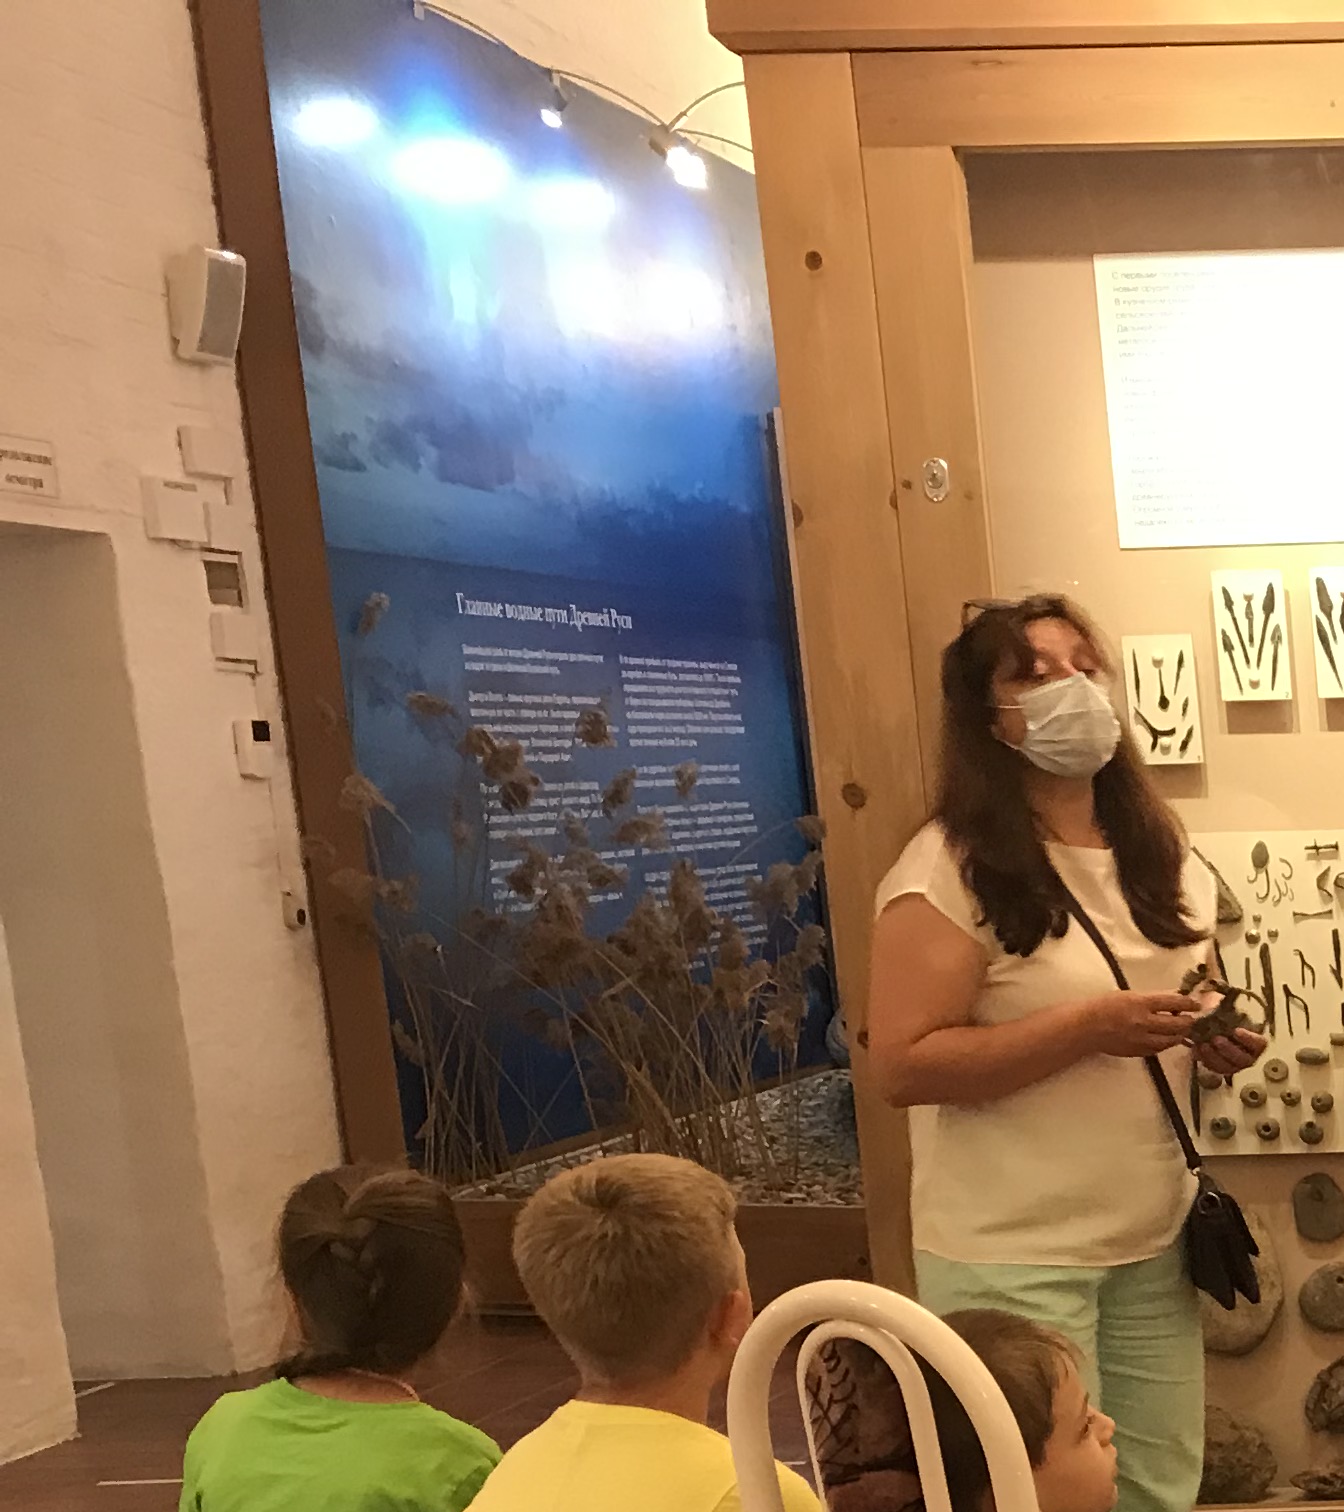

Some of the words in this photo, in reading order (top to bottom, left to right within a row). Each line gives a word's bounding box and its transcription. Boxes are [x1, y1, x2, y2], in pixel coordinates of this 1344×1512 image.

[455, 592, 503, 618] Главные
[505, 603, 544, 622] водные
[544, 608, 569, 630] пути
[568, 604, 611, 632] Древней
[610, 607, 633, 635] Руси
